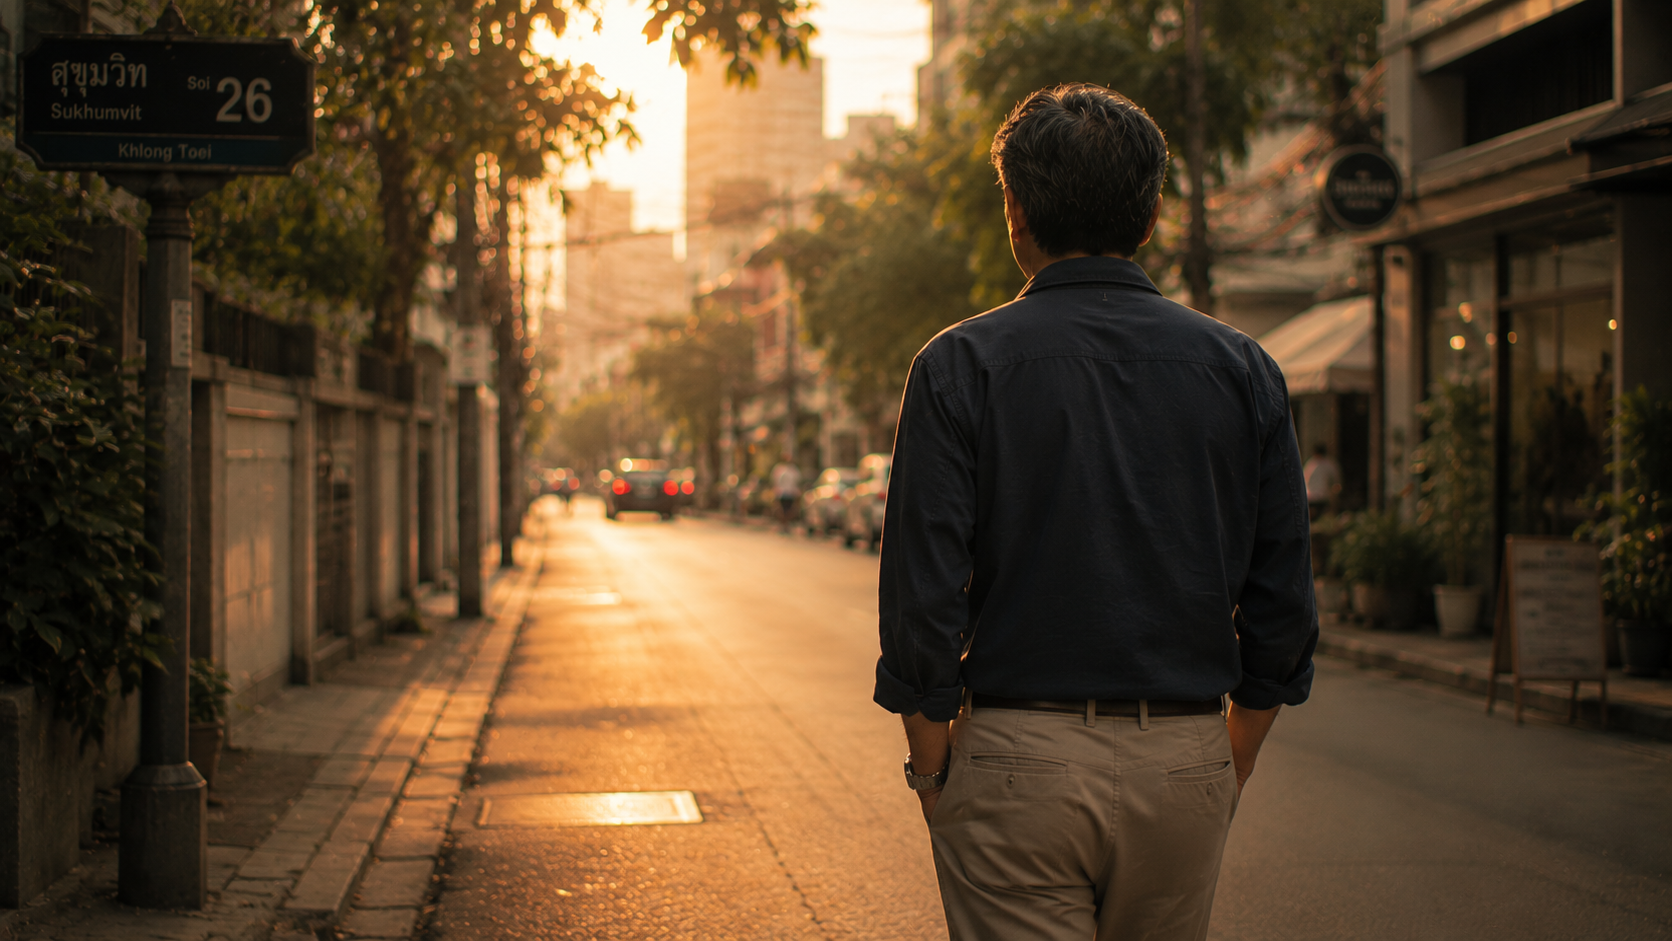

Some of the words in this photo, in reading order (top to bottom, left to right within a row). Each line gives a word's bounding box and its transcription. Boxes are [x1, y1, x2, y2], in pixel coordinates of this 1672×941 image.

[187, 75, 210, 90] Soi
[215, 76, 273, 124] 26
[50, 101, 142, 121] Sukhumvit
[117, 142, 173, 163] Khlong
[177, 143, 212, 160] Toei
